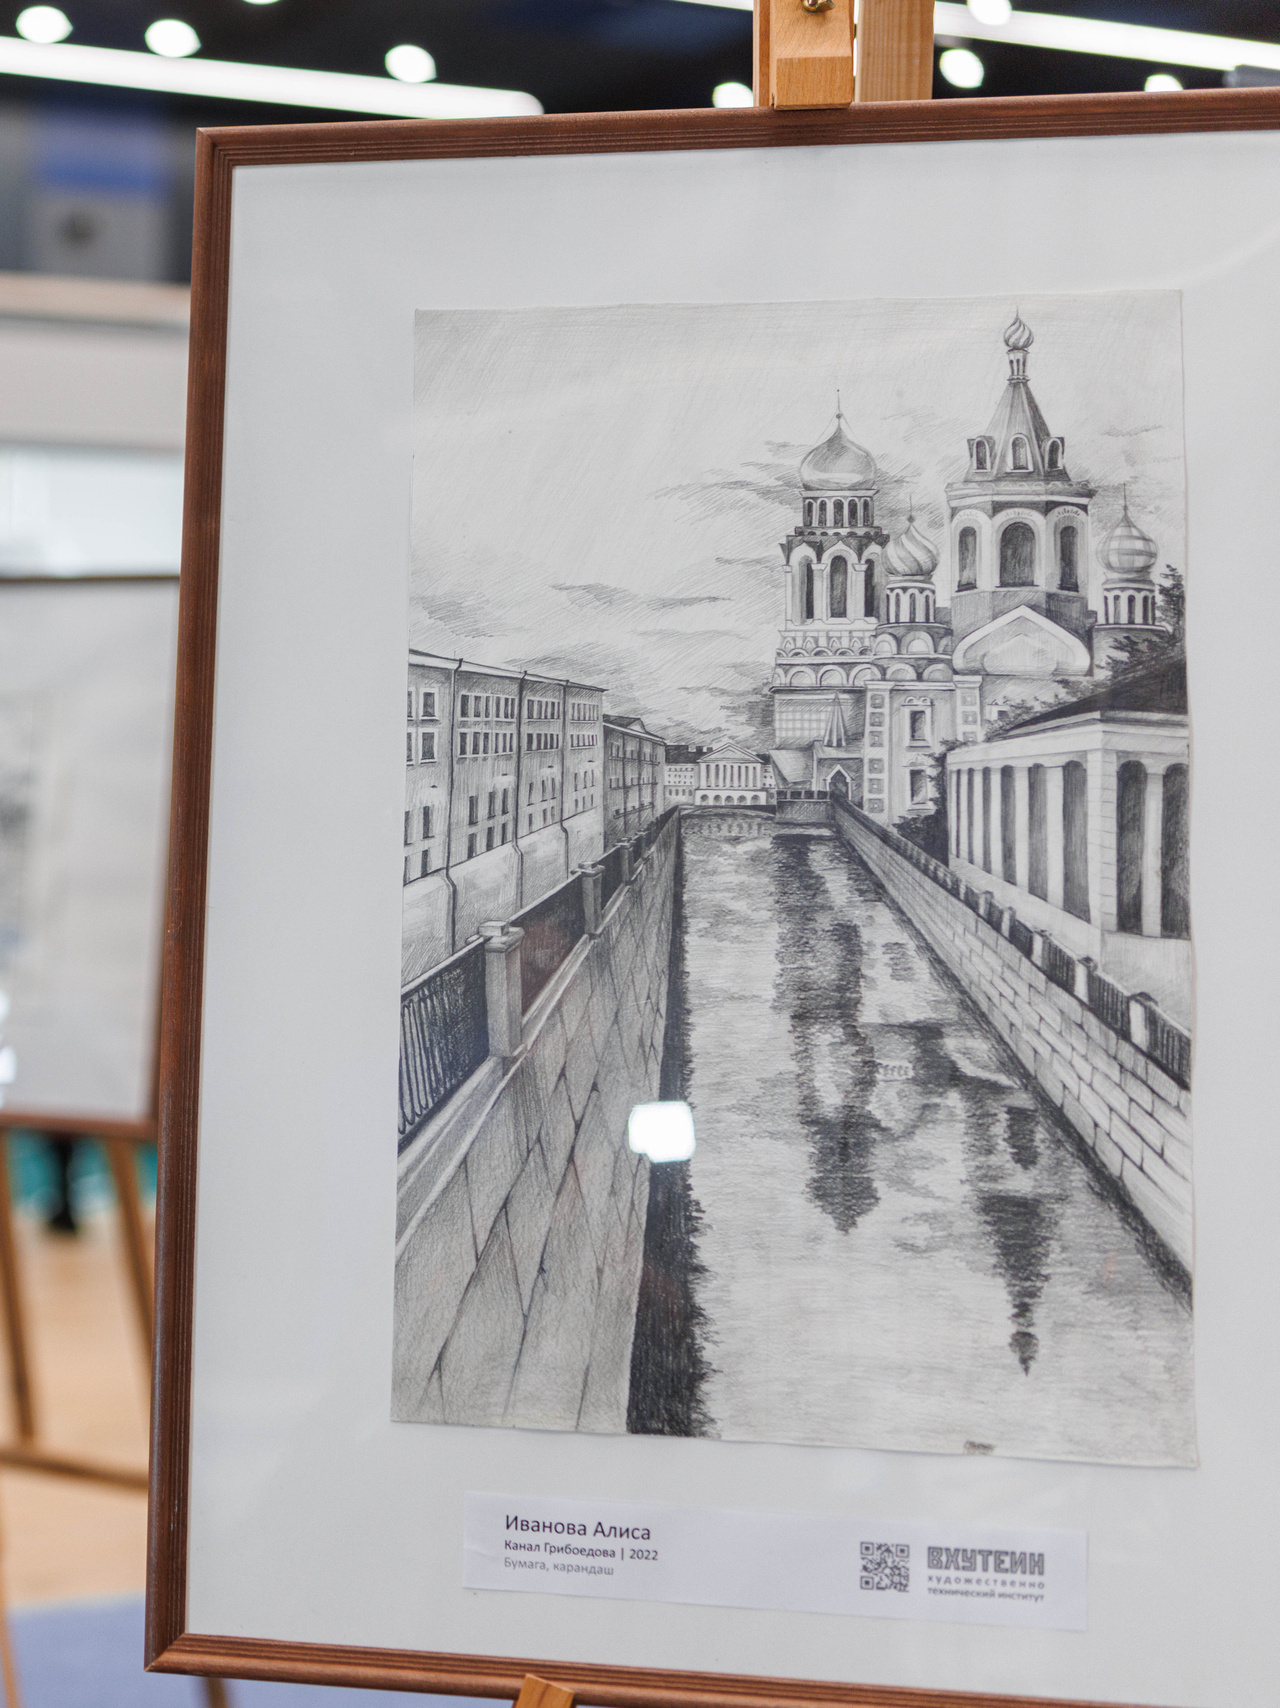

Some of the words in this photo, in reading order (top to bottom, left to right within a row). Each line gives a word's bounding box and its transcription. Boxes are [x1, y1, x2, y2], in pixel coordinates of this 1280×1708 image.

[505, 1514, 587, 1536] Иванова
[593, 1521, 651, 1540] Алиса
[504, 1539, 541, 1553] Канал
[544, 1542, 616, 1558] Грибоедова
[629, 1549, 658, 1561] 2022
[504, 1557, 549, 1572] Бумага,
[553, 1561, 614, 1576] карандаш
[927, 1546, 1045, 1576] ВХУТЕИН
[927, 1574, 1045, 1590] художественно
[927, 1587, 996, 1599] технический
[998, 1591, 1045, 1603] институт
